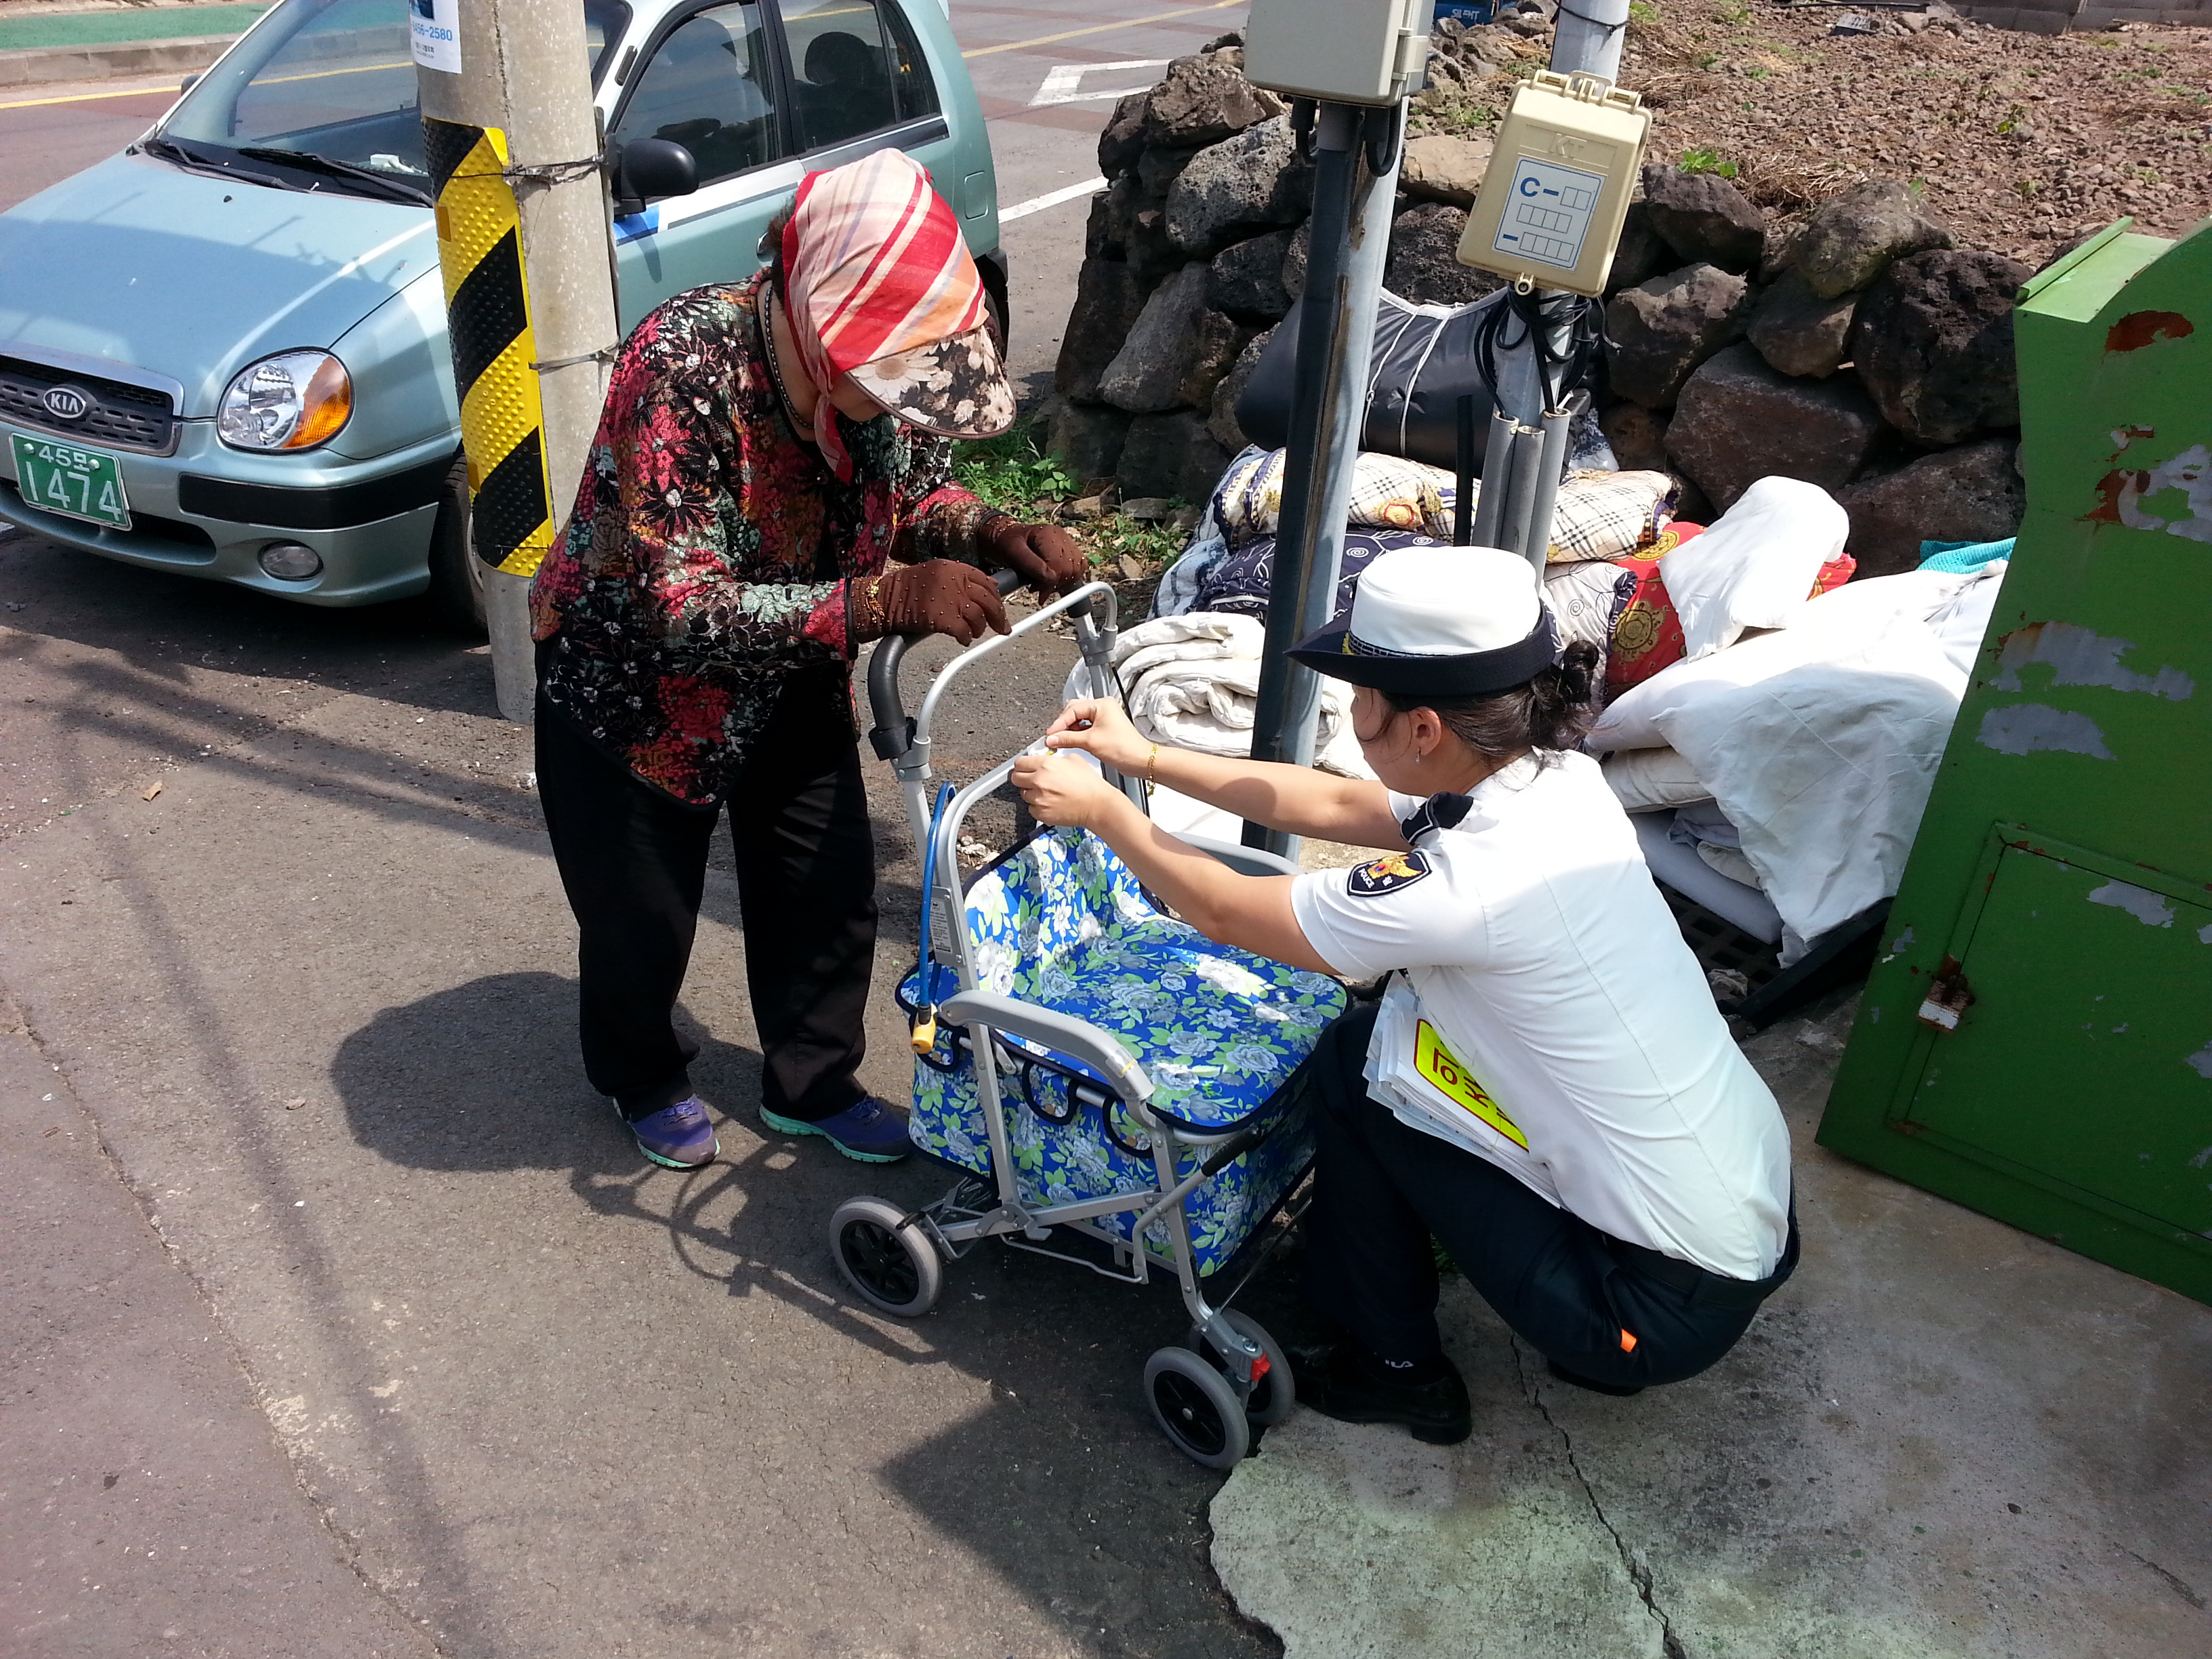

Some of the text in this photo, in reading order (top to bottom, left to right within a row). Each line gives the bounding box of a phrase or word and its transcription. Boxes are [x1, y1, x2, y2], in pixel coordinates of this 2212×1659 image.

[51, 392, 79, 413] KIA
[39, 445, 90, 472] 45모
[26, 462, 121, 521] 1474
[1358, 868, 1375, 888] POLICE
